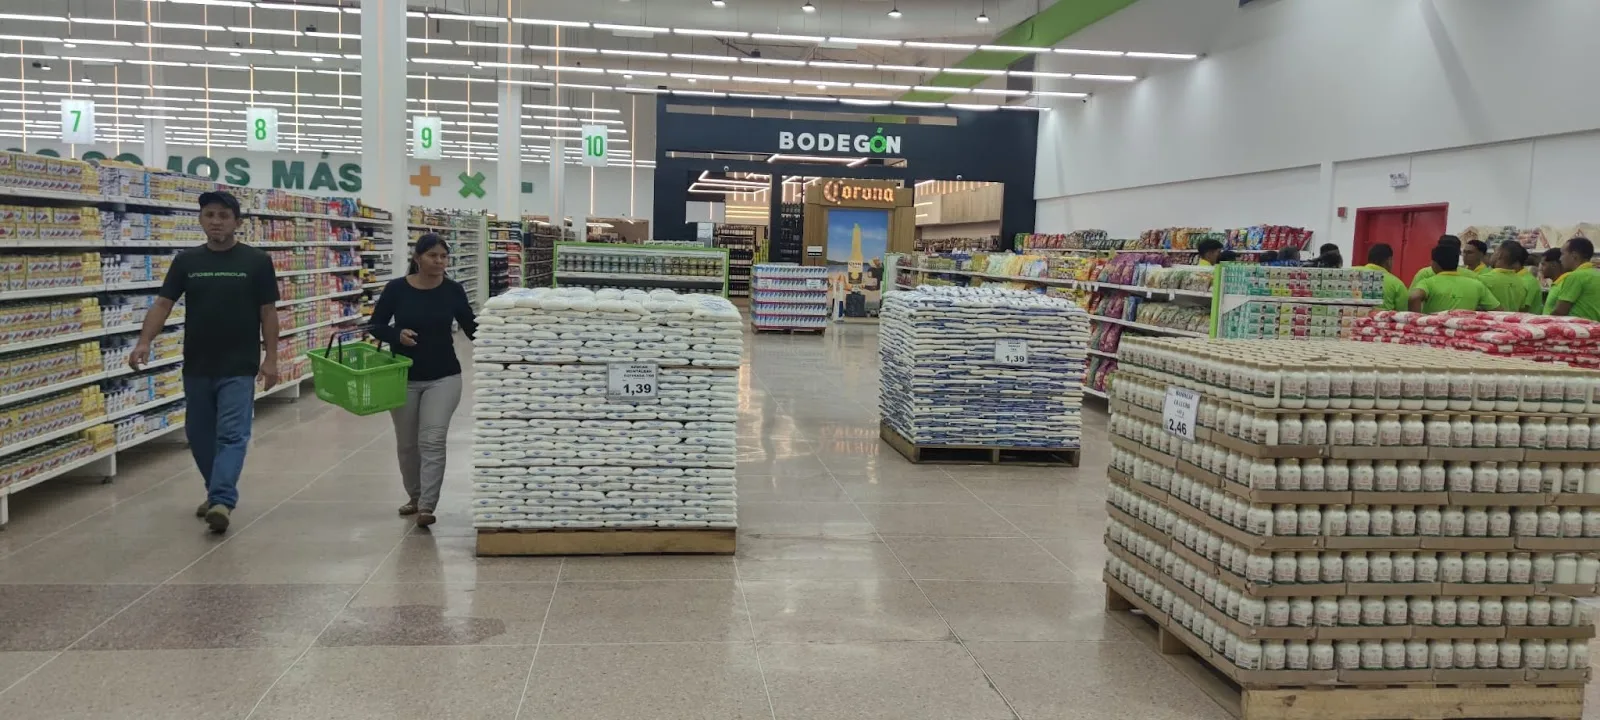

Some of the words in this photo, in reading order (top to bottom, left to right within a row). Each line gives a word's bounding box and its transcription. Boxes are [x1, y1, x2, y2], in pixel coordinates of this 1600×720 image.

[70, 110, 82, 133] 7
[255, 118, 267, 141] 8
[421, 127, 432, 149] 9
[585, 135, 604, 157] 10
[779, 127, 901, 154] BODEGÓN
[271, 152, 362, 192] MÁS
[823, 179, 895, 205] Corona
[623, 384, 652, 396] 1,39
[1169, 418, 1186, 435] 2,46
